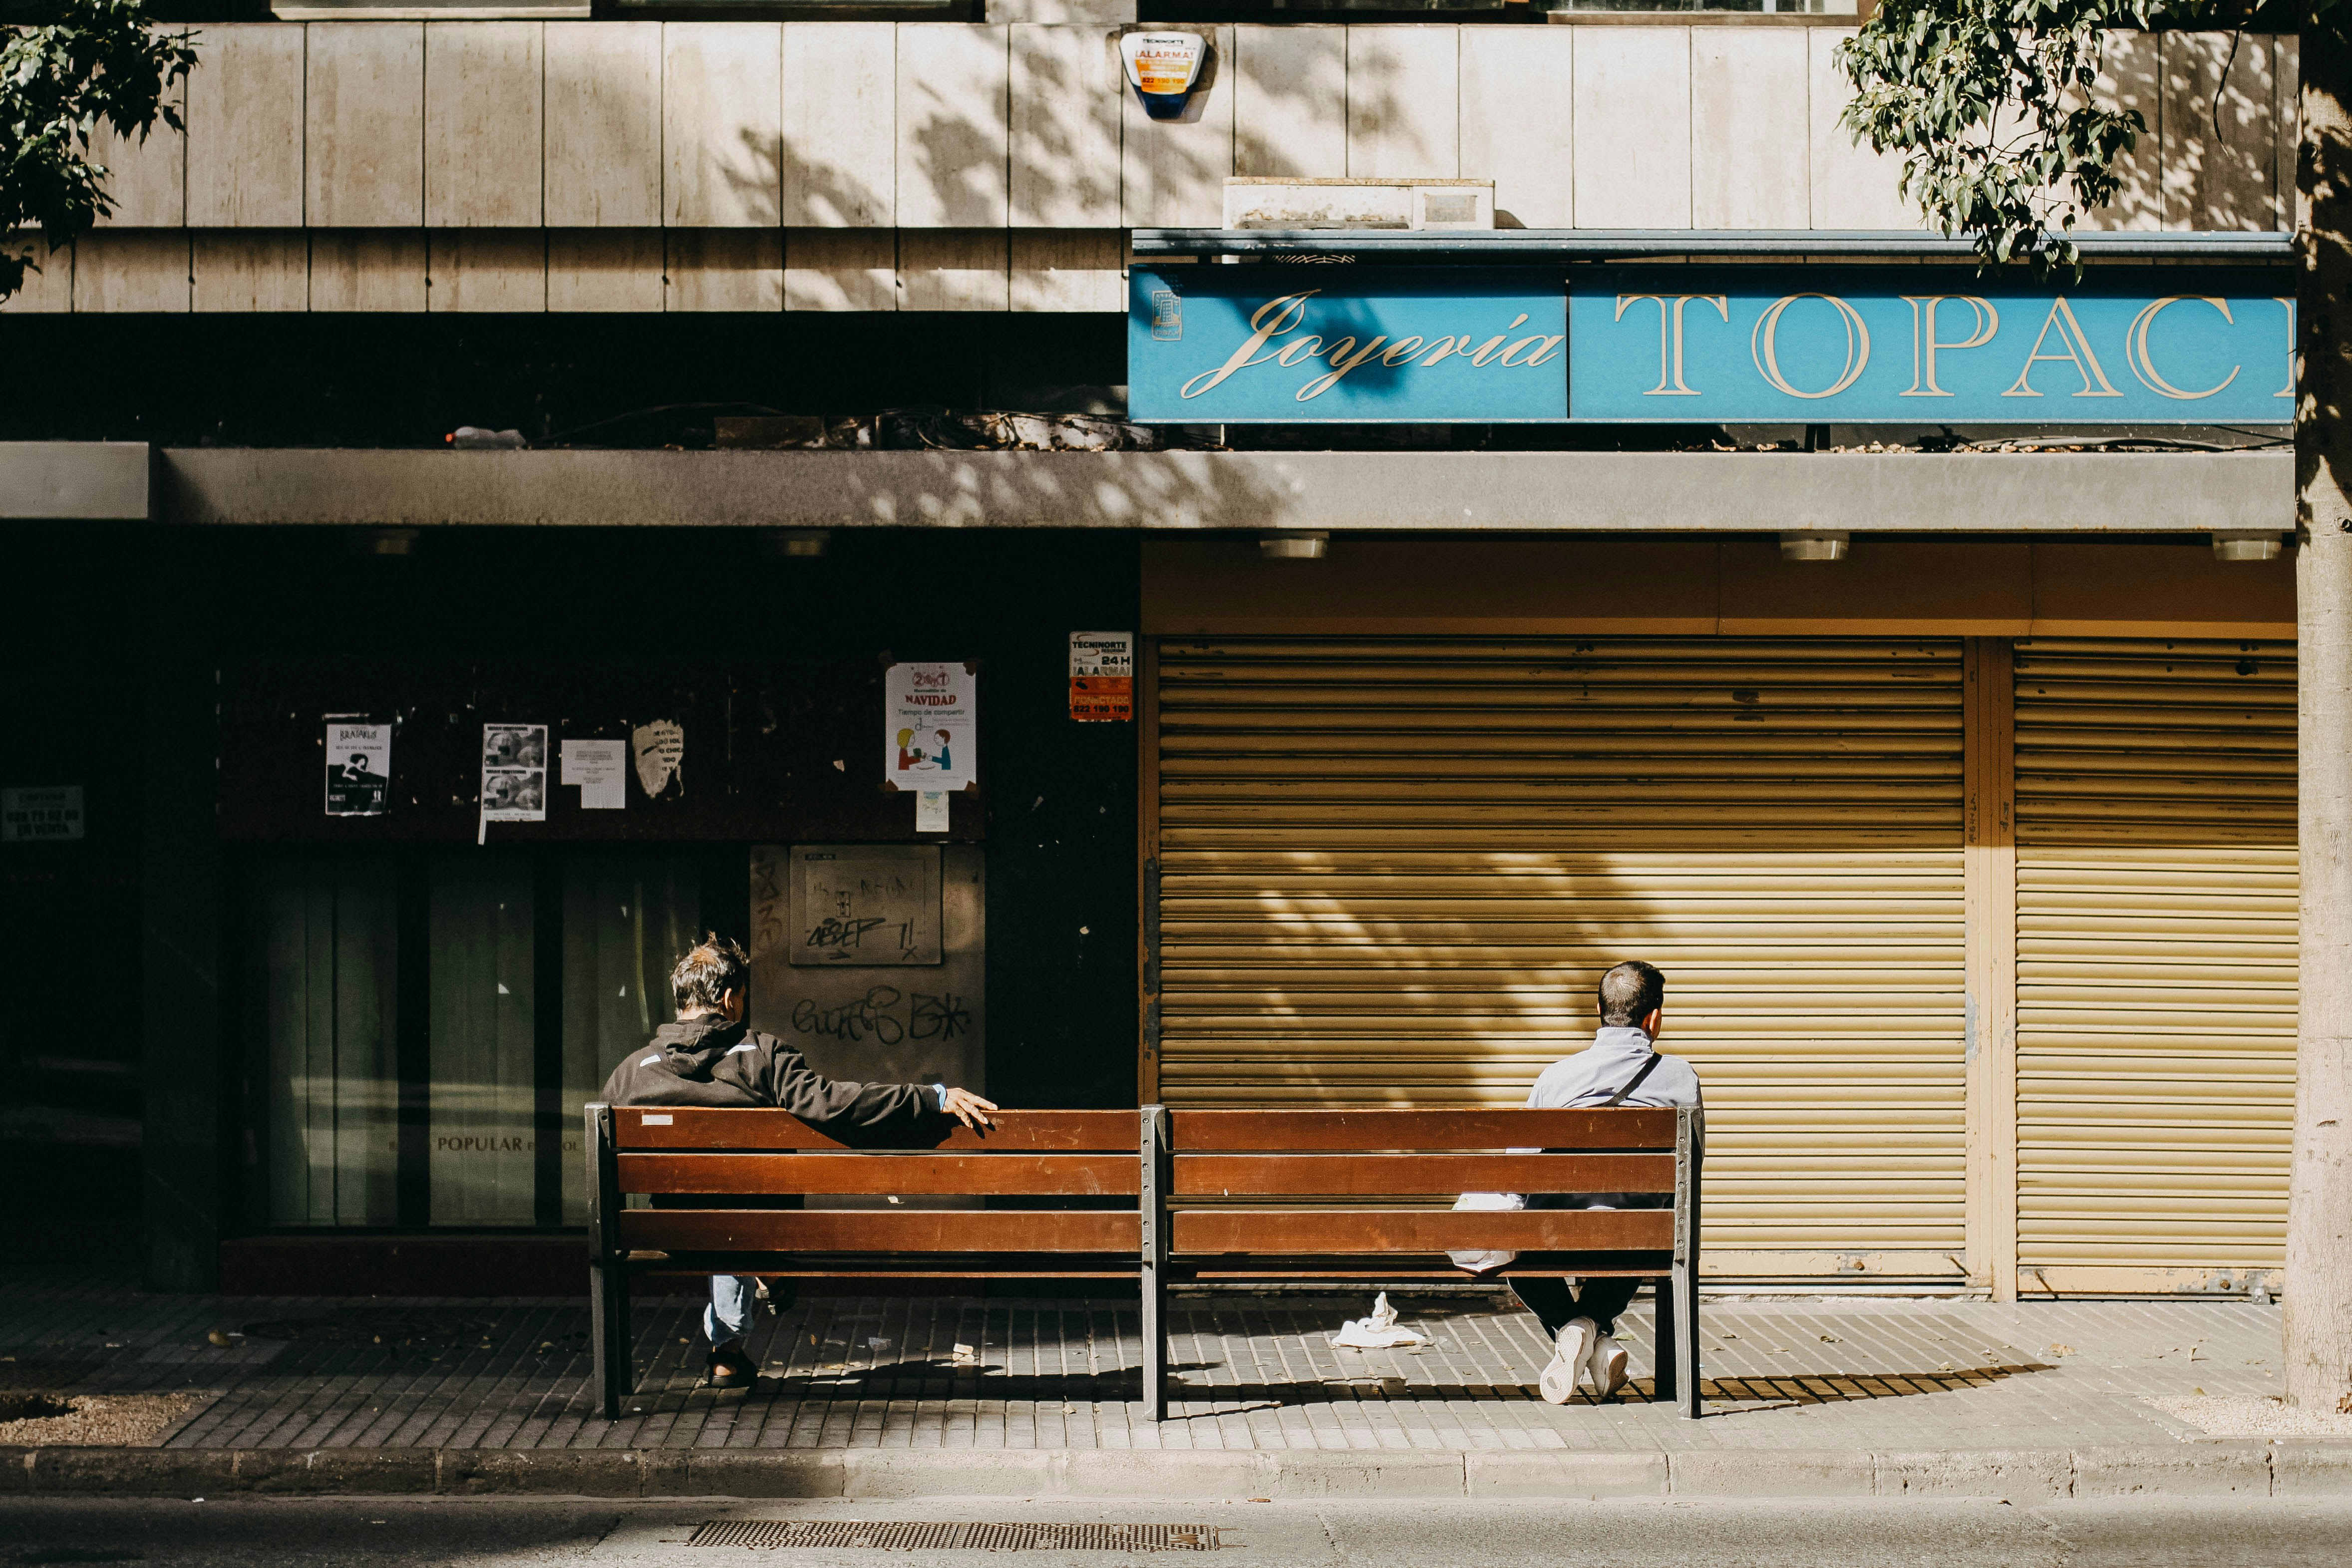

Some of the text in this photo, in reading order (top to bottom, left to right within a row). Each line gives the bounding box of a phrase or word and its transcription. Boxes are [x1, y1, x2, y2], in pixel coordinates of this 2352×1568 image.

[1181, 289, 1565, 401] Joyería
[905, 694, 957, 706] NAVIDAD
[437, 1137, 522, 1151] POPULAR
